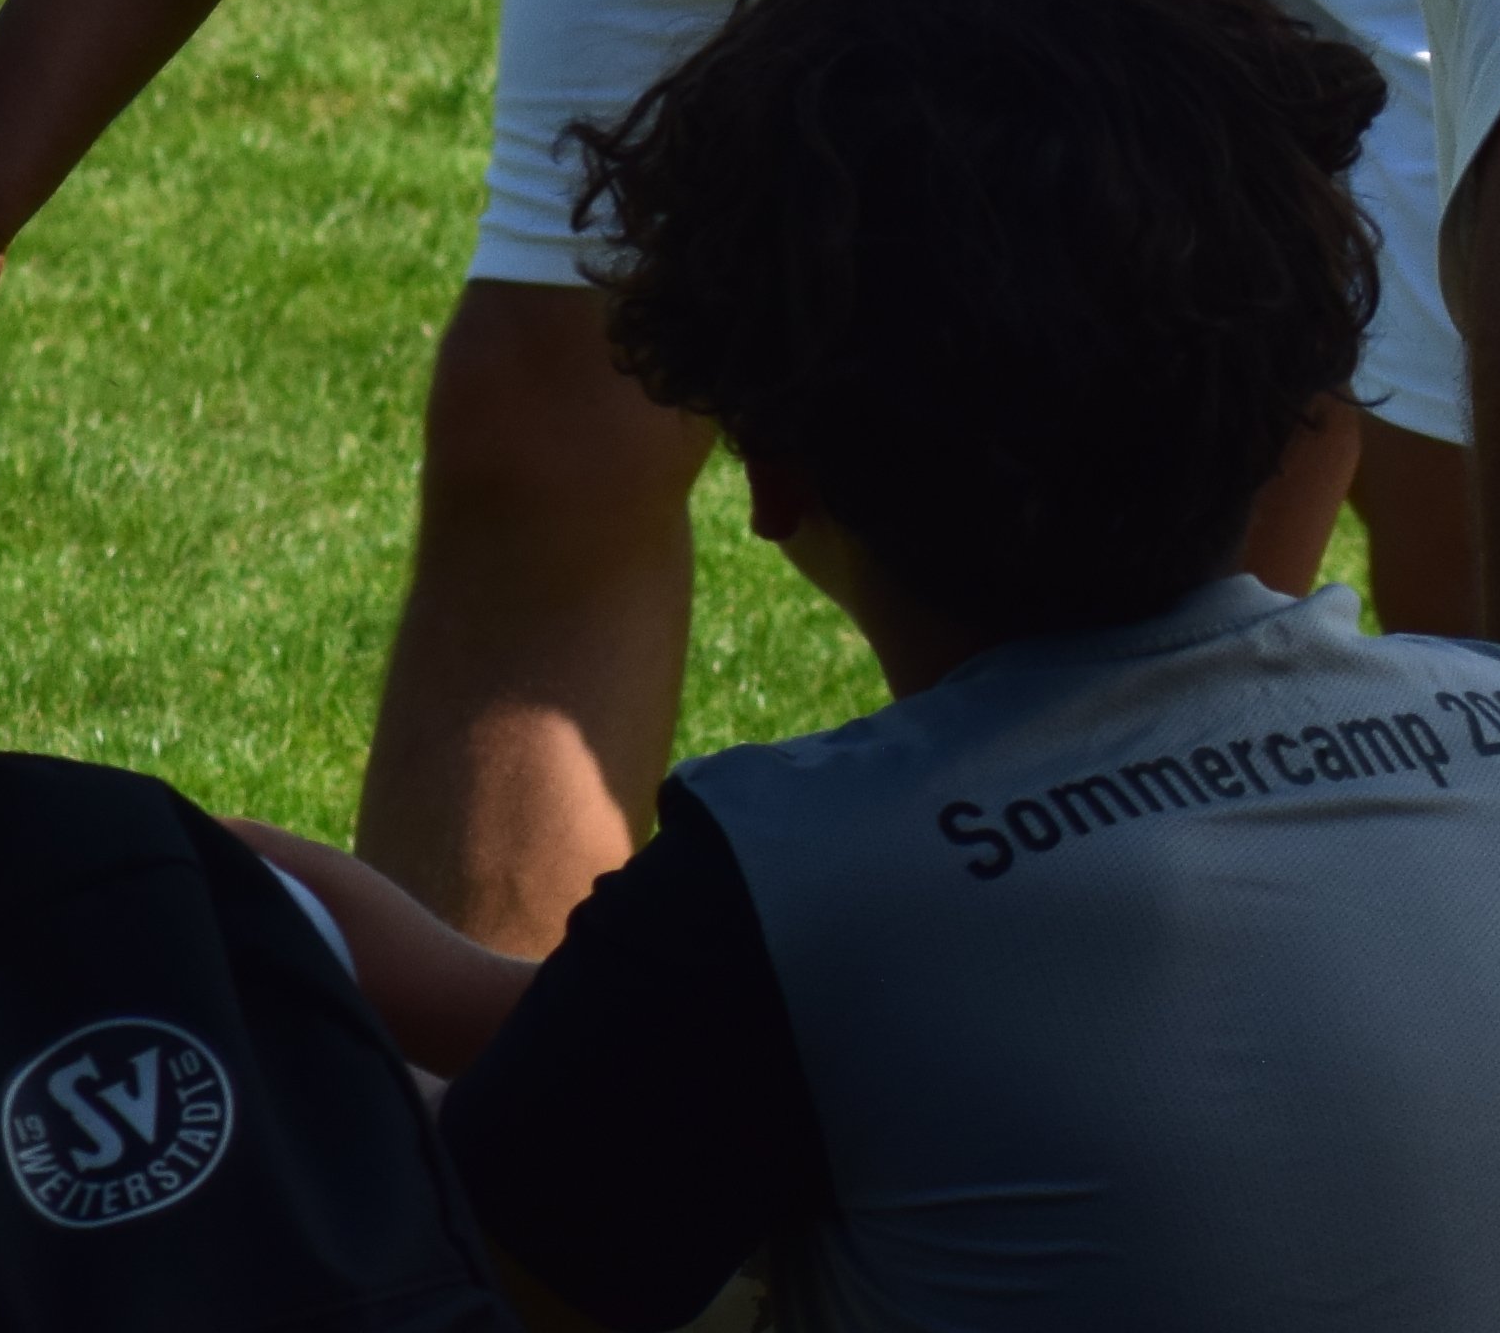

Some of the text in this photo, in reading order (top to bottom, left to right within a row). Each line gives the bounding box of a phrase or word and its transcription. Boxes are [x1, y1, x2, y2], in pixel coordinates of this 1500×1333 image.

[937, 704, 1450, 880] Sommercamp
[17, 1078, 223, 1217] WEITERSTADT
[48, 1046, 161, 1172] SV
